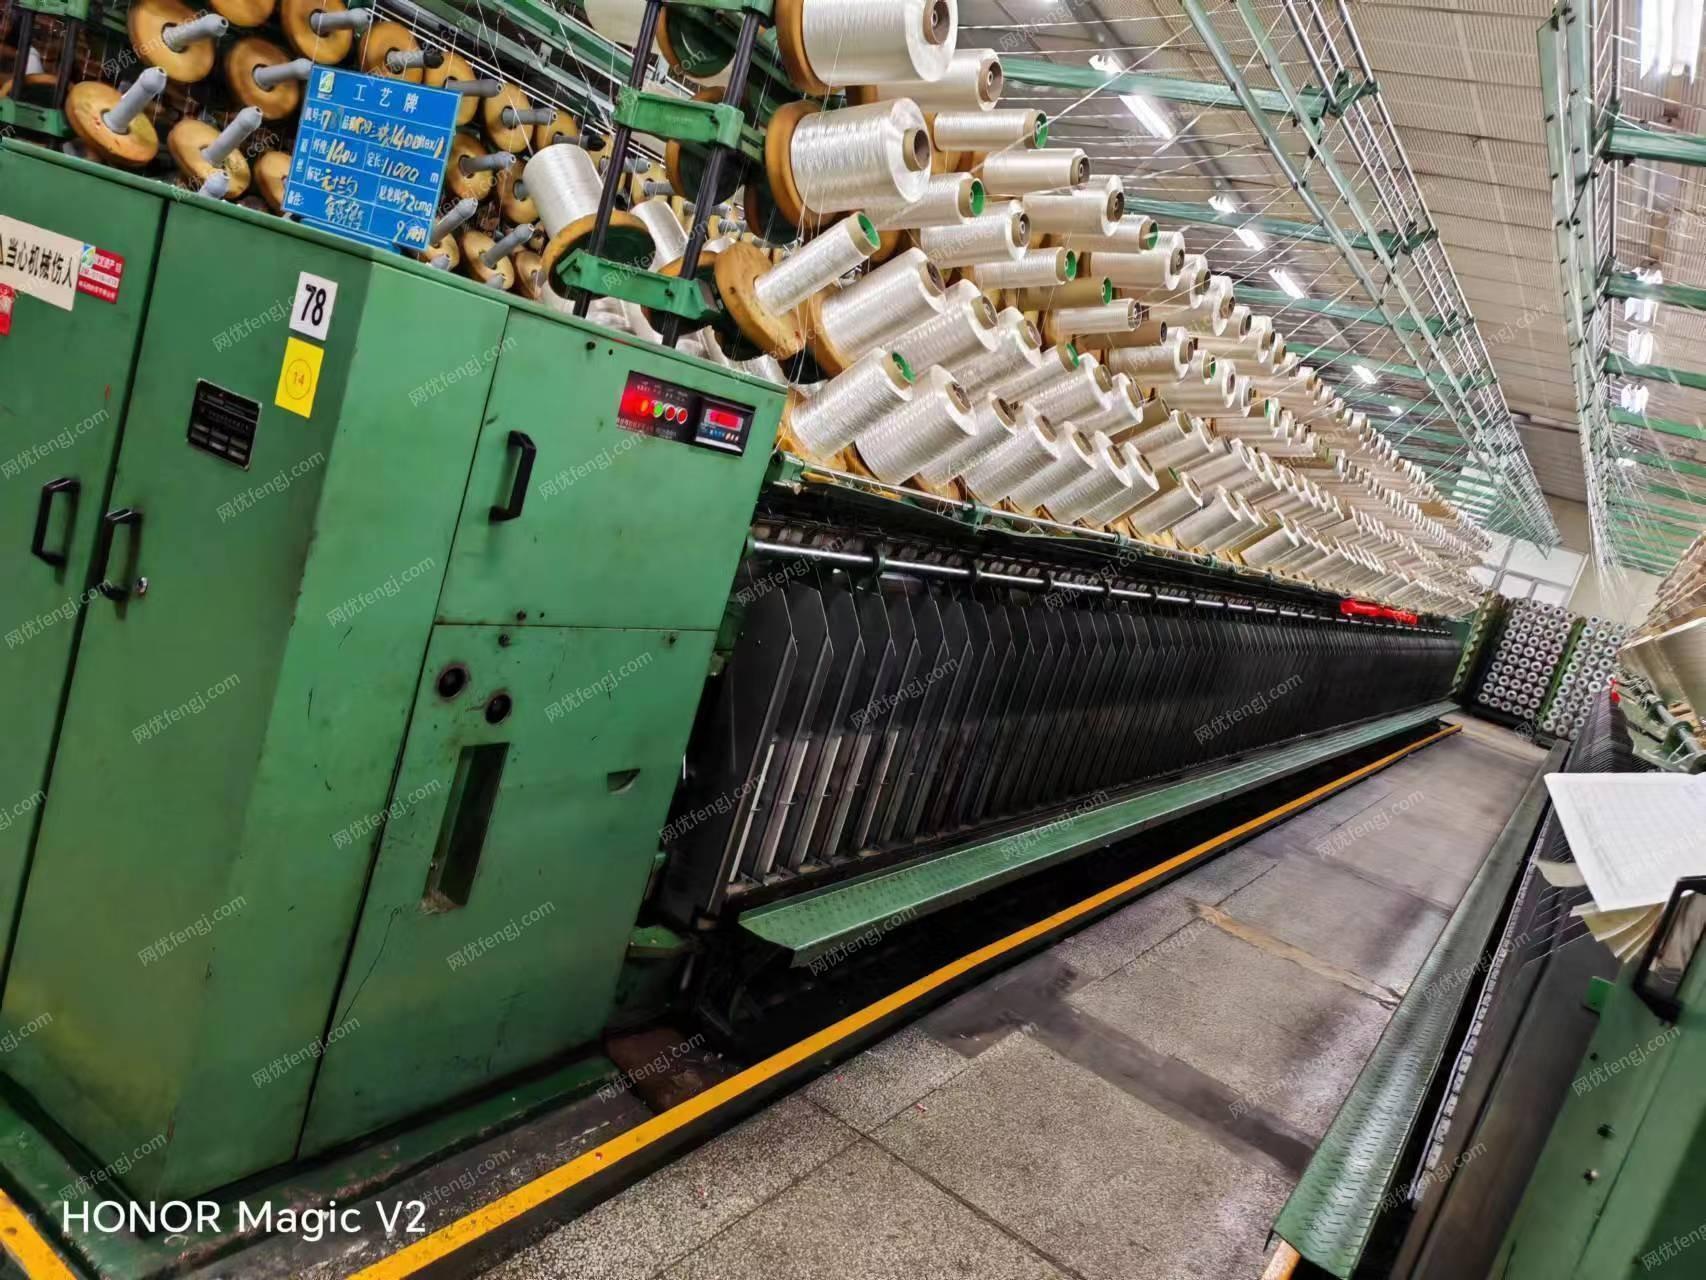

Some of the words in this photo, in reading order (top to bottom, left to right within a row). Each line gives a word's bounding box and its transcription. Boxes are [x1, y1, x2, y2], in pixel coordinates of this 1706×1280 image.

[6, 237, 72, 288] 当心机械伤人
[301, 284, 327, 326] 78
